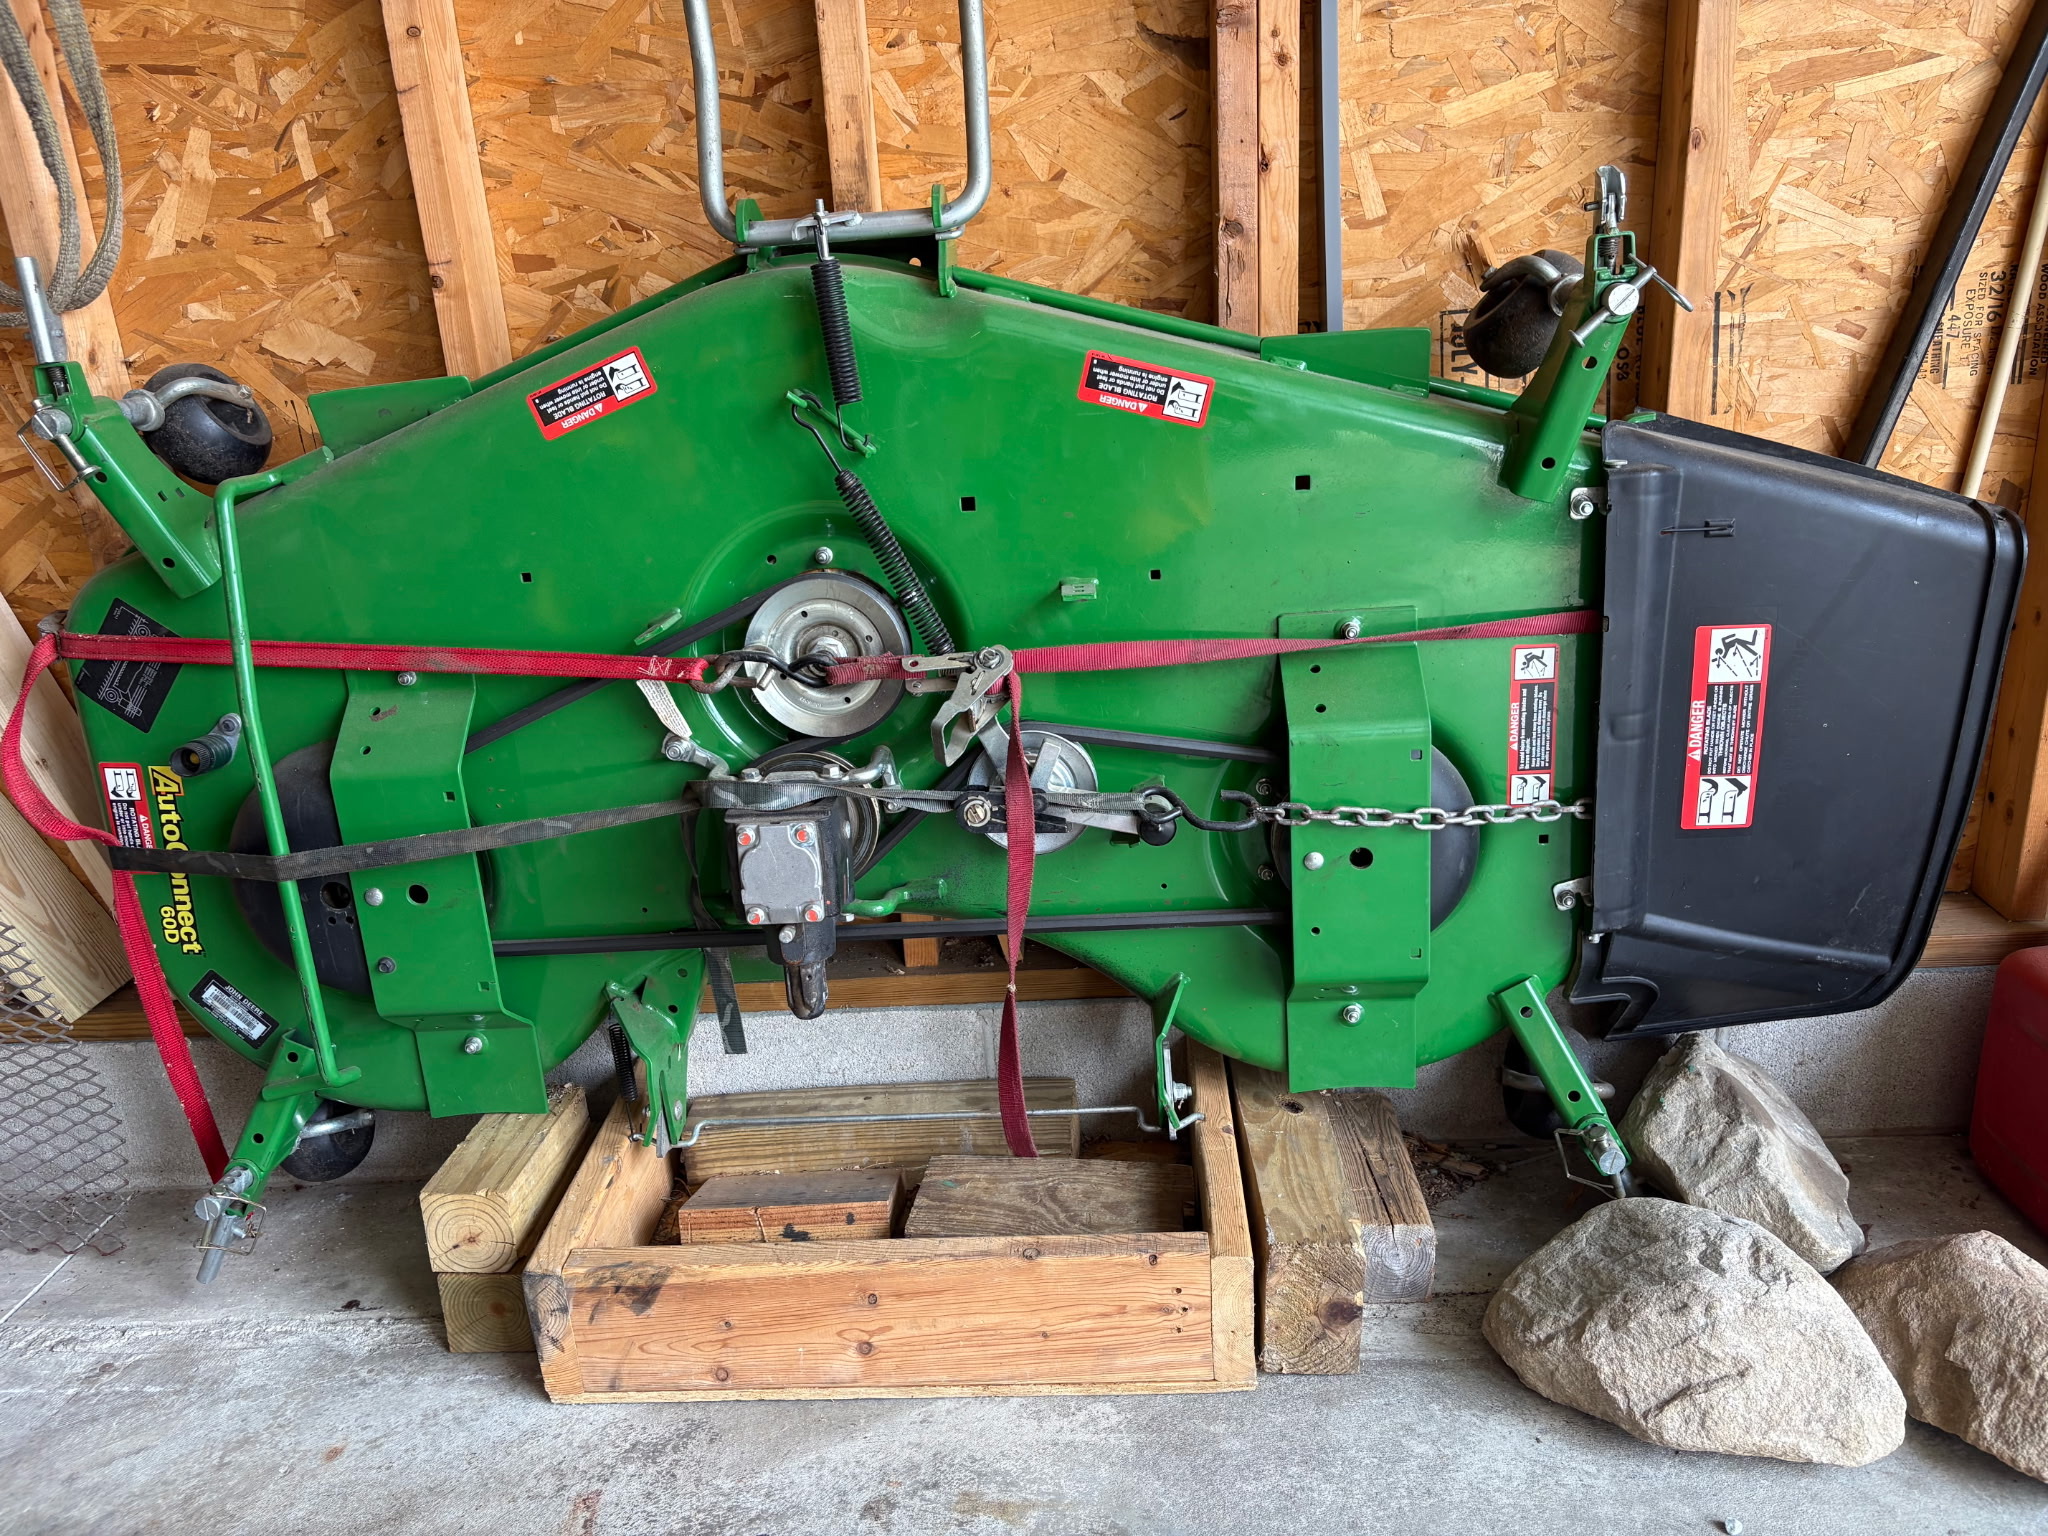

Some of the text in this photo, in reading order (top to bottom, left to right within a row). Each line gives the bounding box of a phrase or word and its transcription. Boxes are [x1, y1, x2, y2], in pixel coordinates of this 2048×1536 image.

[2038, 263, 2048, 299] WOOD
[1985, 269, 2006, 323] 32/16
[1945, 314, 1961, 338] 447
[1960, 288, 1975, 349] EXPOSURE
[1969, 271, 1987, 376] SIZED FOR SPACING
[583, 371, 601, 381] engine
[1109, 371, 1128, 379] mower
[1118, 365, 1140, 375] running
[1148, 373, 1167, 381] engine
[589, 376, 604, 386] under
[1116, 379, 1134, 387] hands
[1129, 375, 1141, 383] into
[557, 382, 577, 394] running
[579, 389, 589, 397] put
[1098, 382, 1157, 401] ROTATING BLADE
[539, 400, 553, 409] when
[552, 391, 605, 419] ROTATING BLADE
[554, 392, 571, 402] mower
[563, 394, 580, 404] hands
[1099, 394, 1136, 409] DANGER
[546, 405, 557, 413] feet
[561, 408, 595, 428] DANGER
[1509, 702, 1519, 741] DANGER
[1688, 700, 1705, 747] DANGER
[122, 802, 127, 810] Do
[129, 807, 139, 837] ROTATING
[140, 822, 152, 848] DANGE
[152, 769, 205, 955] AutoCnnect
[160, 905, 180, 944] 60D
[224, 985, 242, 999] JOHN
[242, 998, 263, 1016] DEERE
